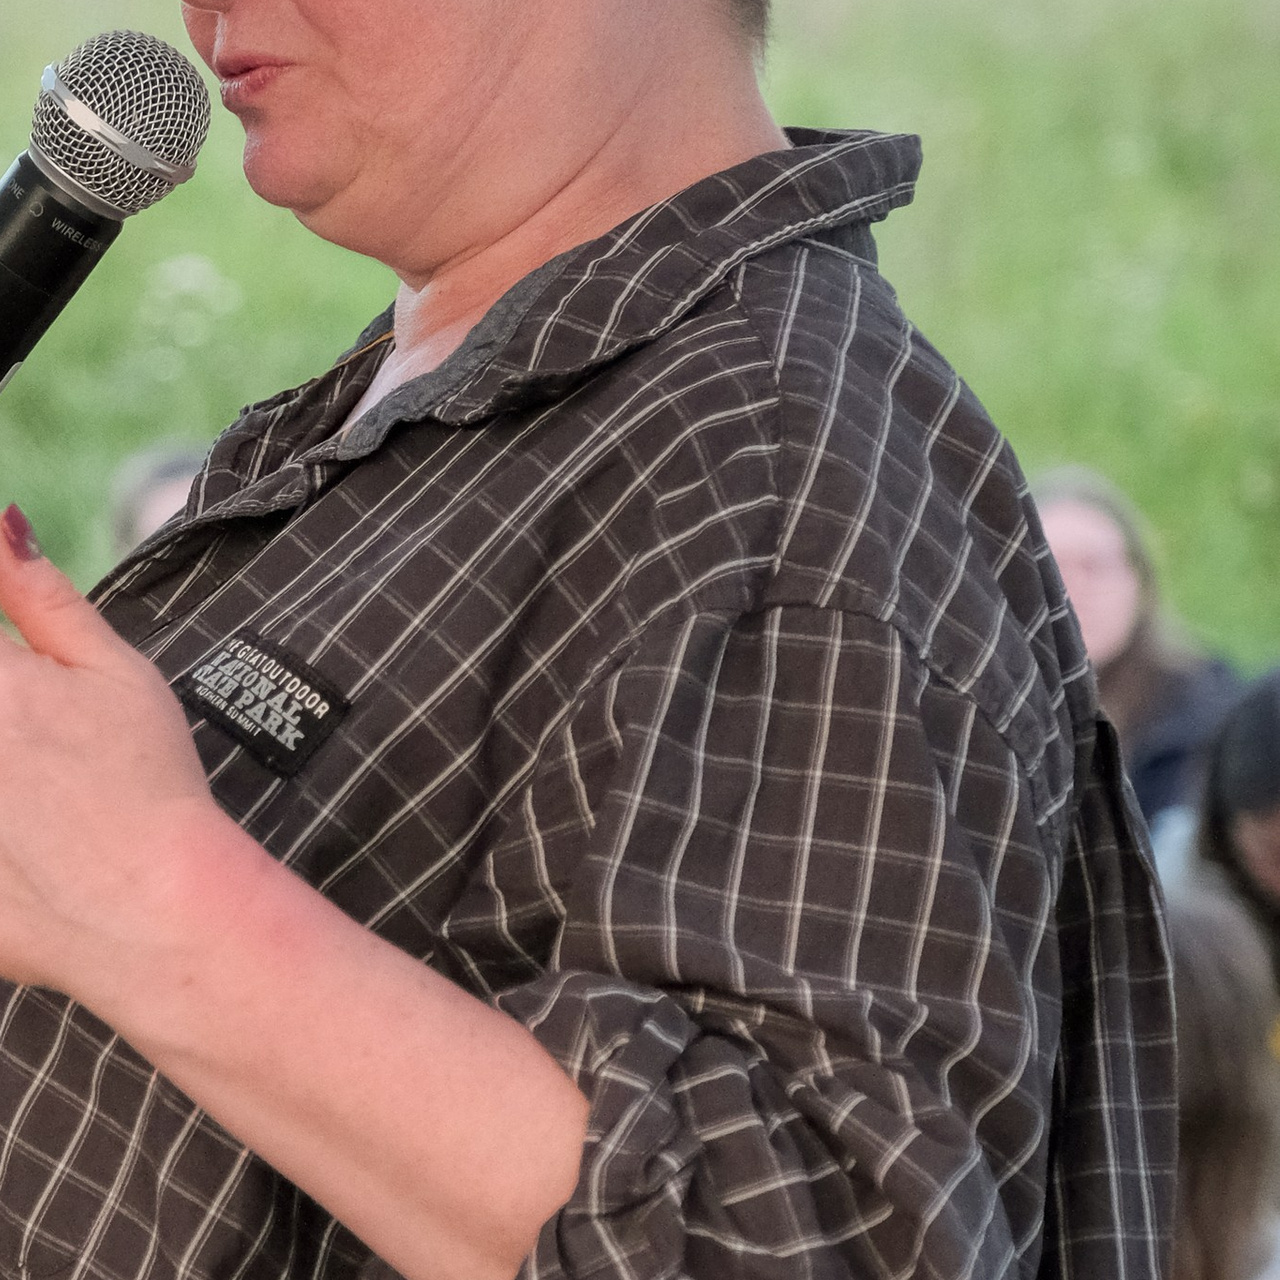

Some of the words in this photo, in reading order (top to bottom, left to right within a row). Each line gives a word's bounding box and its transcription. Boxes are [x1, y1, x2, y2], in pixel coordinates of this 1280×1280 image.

[8, 178, 25, 200] ONE
[51, 217, 103, 252] WIRELESS
[195, 685, 229, 712] NORHERN
[226, 705, 262, 737] SUMMIT
[211, 651, 304, 726] NATIONAL
[237, 645, 268, 669] GEAT
[262, 659, 330, 720] OUTDOOR
[234, 689, 306, 752] PARK
